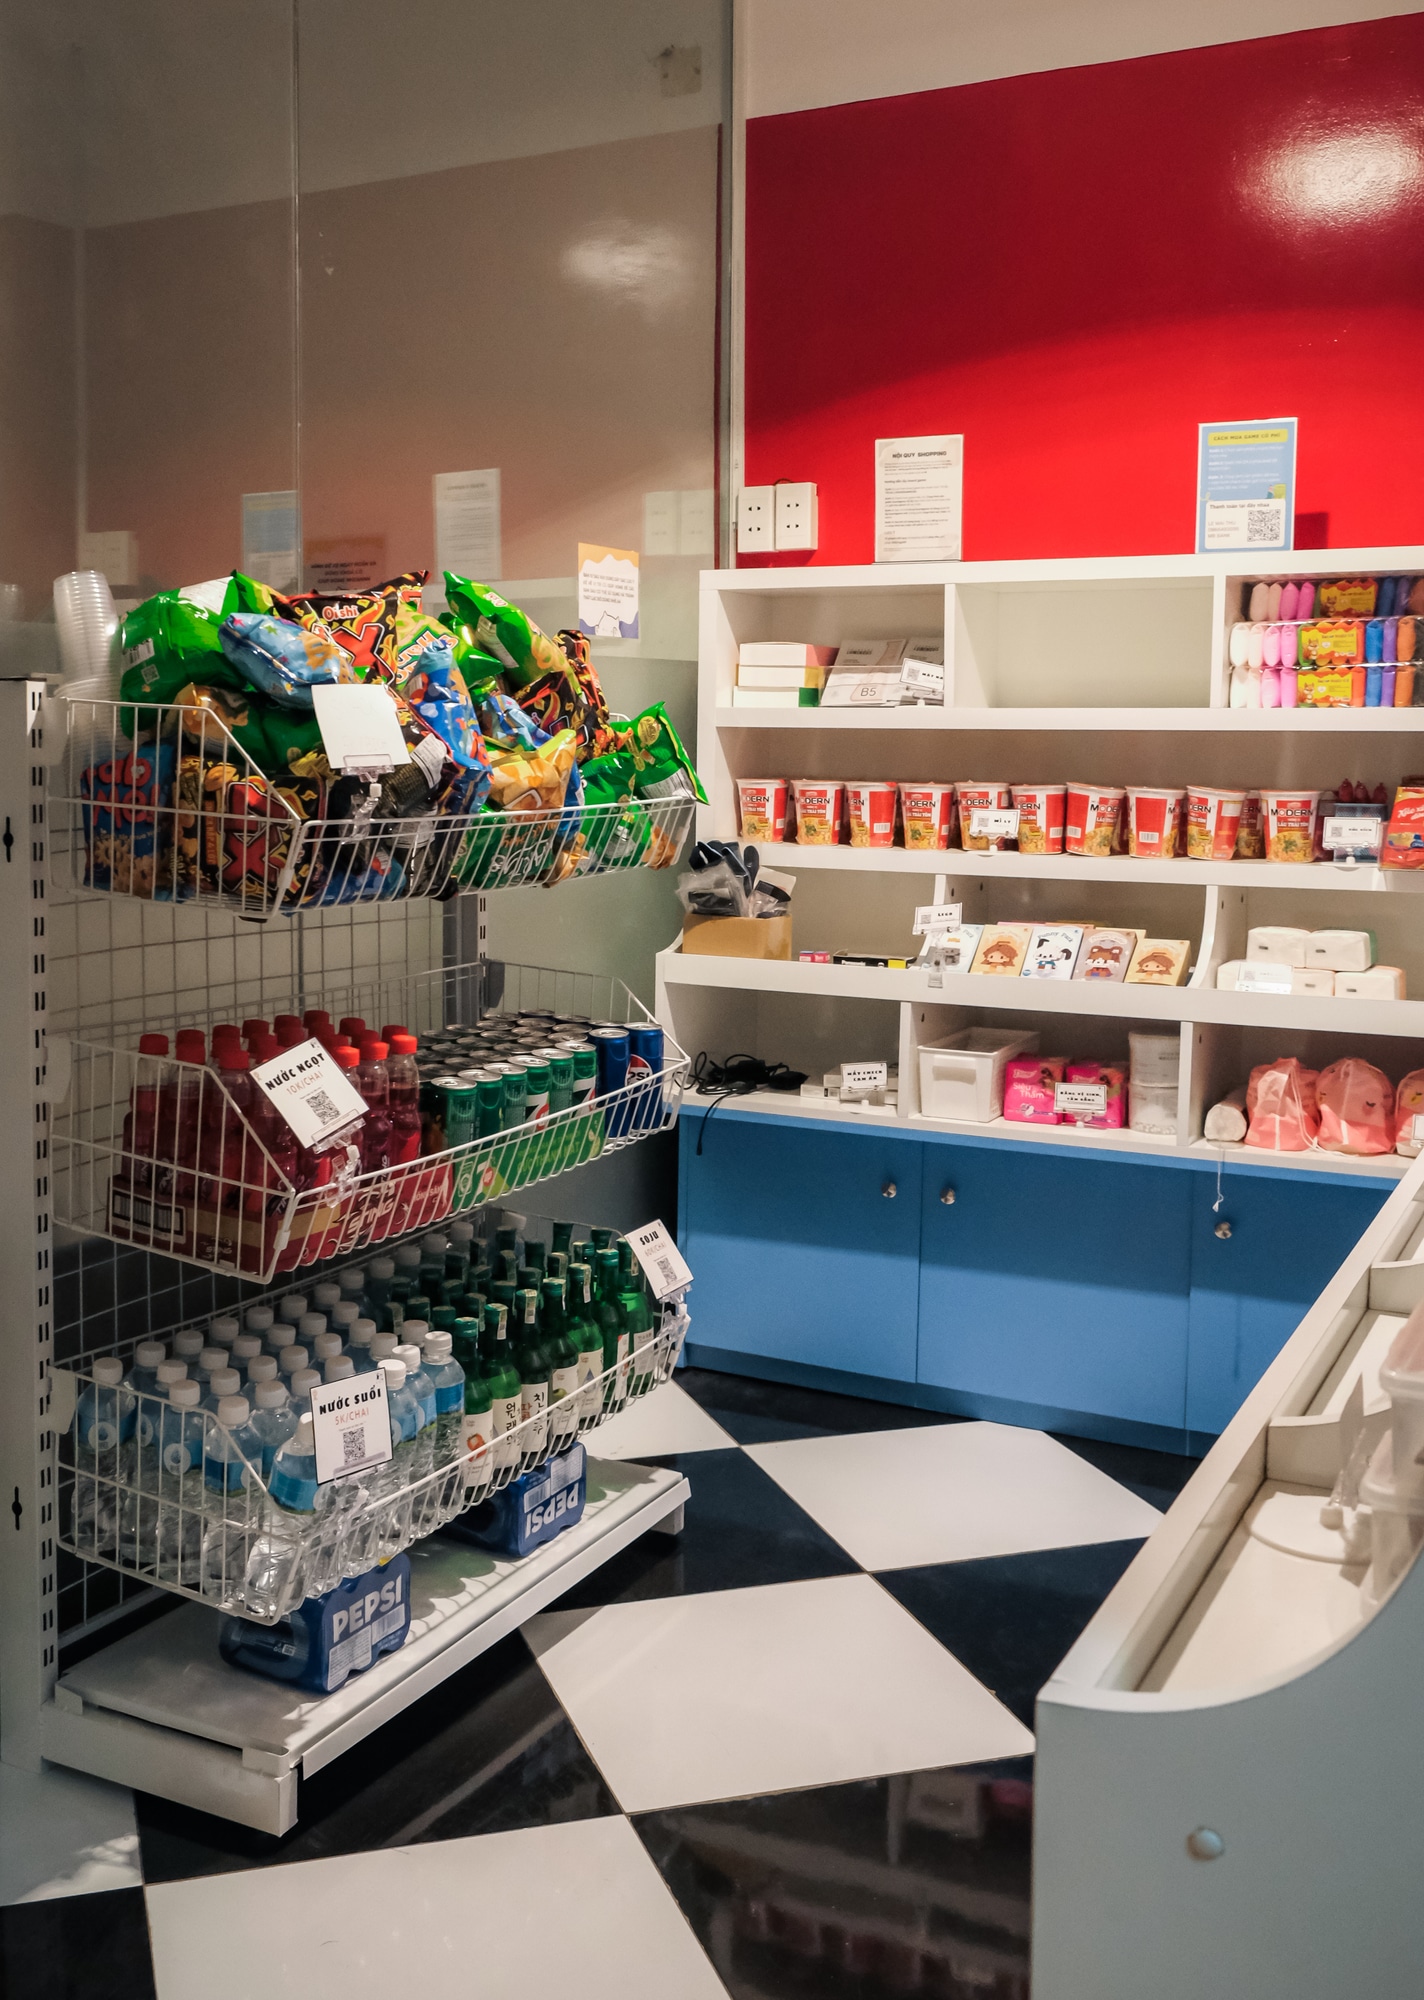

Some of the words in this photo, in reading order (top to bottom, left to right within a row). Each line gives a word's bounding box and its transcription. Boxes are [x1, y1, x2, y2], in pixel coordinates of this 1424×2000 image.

[322, 605, 360, 622] Oishi
[860, 688, 876, 696] B5
[265, 1069, 296, 1090] NƯỚC
[296, 1053, 325, 1073] NGỌT
[286, 1071, 323, 1095] 10K/CHAI
[1020, 1089, 1044, 1099] Thấm
[640, 1230, 659, 1246] SOJU
[320, 1396, 350, 1415] NƯỚC
[354, 1384, 381, 1404] SUỐI
[335, 1407, 369, 1425] 5K/CHAI
[525, 1482, 579, 1540] PEPSI
[332, 1574, 402, 1644] PEPSI
